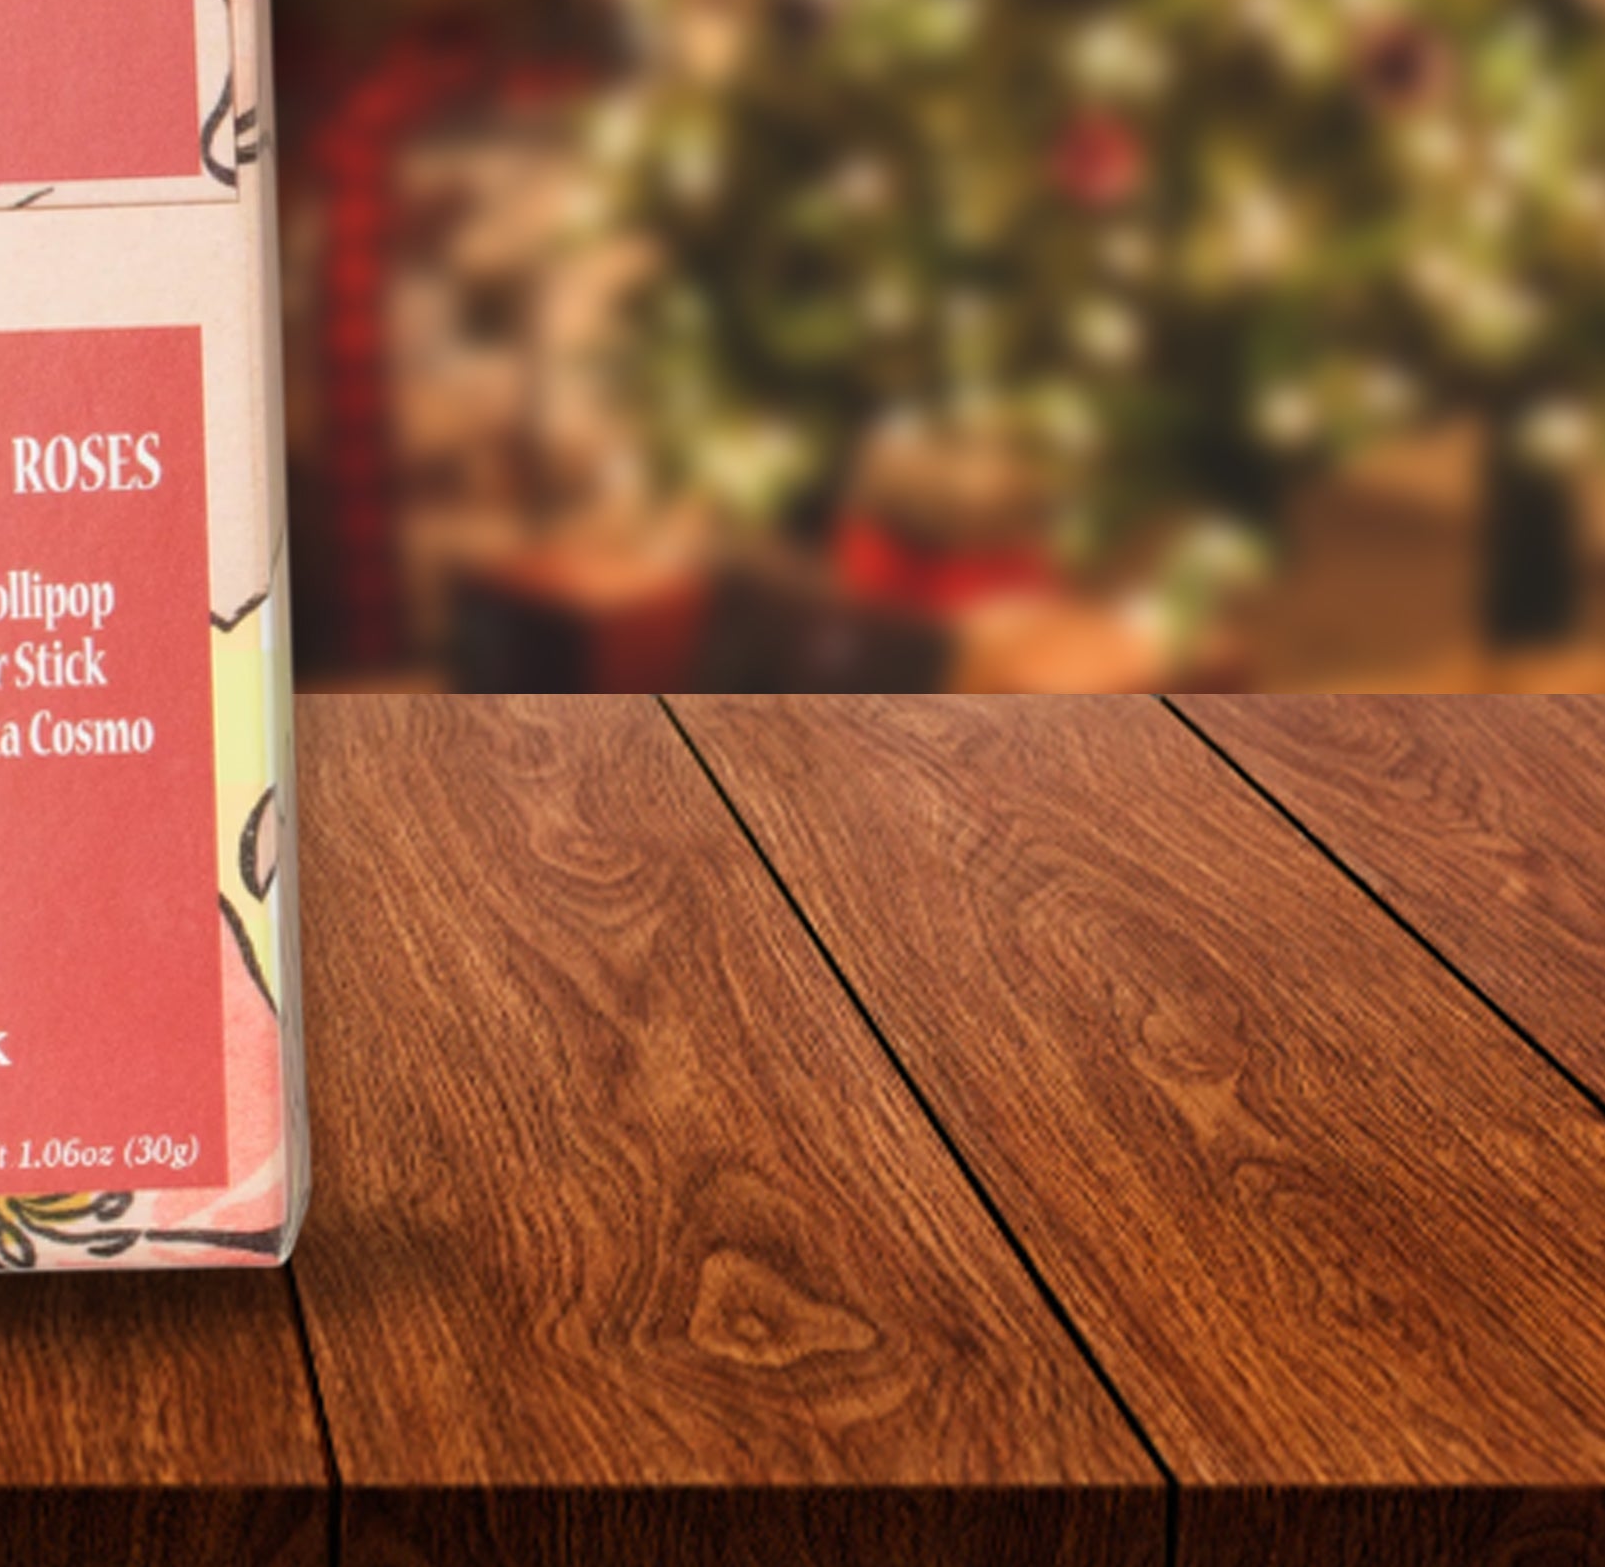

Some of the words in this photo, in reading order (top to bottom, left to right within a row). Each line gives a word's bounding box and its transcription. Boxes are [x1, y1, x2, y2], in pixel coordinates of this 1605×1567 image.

[12, 432, 163, 494] ROSES
[14, 636, 108, 689] Stick
[28, 710, 154, 756] Cosmo
[17, 1136, 115, 1171] 1.06oz
[122, 1133, 200, 1171] (30g)
